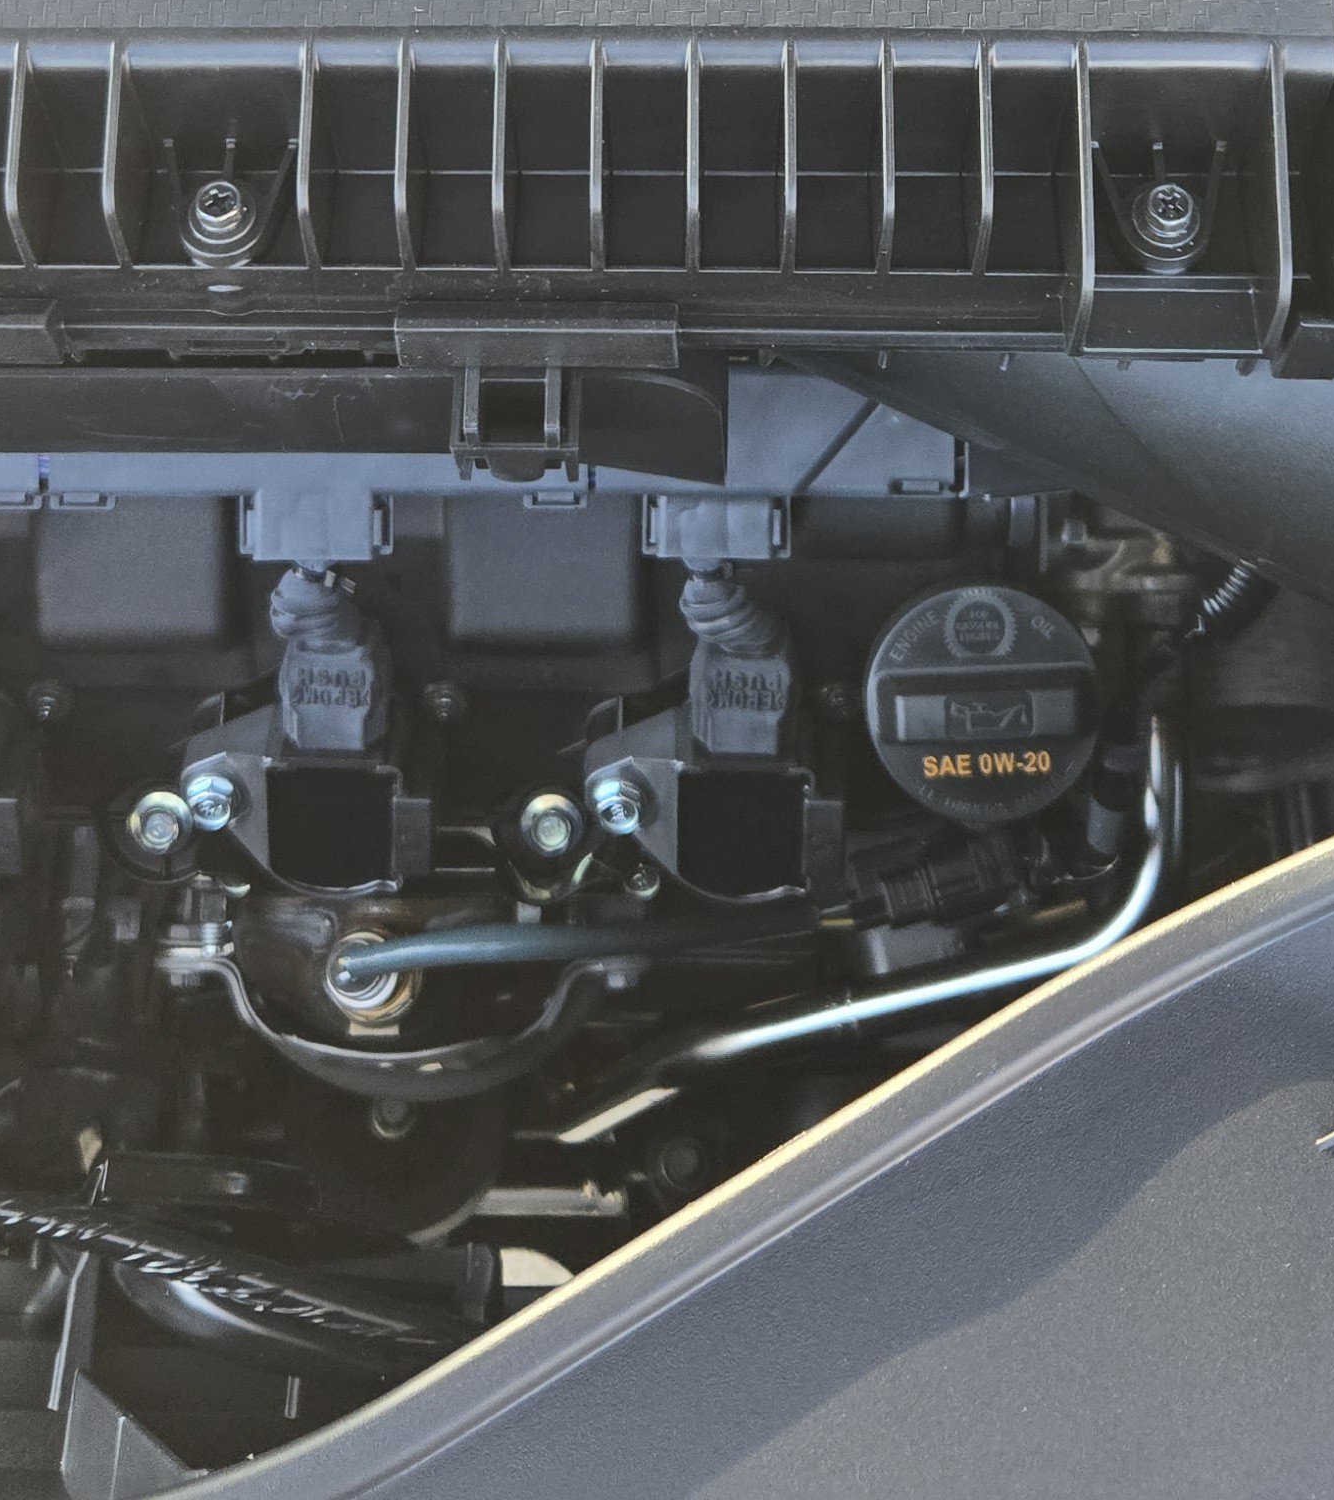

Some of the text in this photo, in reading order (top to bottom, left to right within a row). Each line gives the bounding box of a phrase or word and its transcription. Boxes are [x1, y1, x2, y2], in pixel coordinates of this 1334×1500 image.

[889, 610, 1058, 663] ENGINE OIL
[297, 669, 367, 687] PUSH
[714, 669, 782, 691] PUSH
[922, 750, 1052, 778] SAE 0W-20
